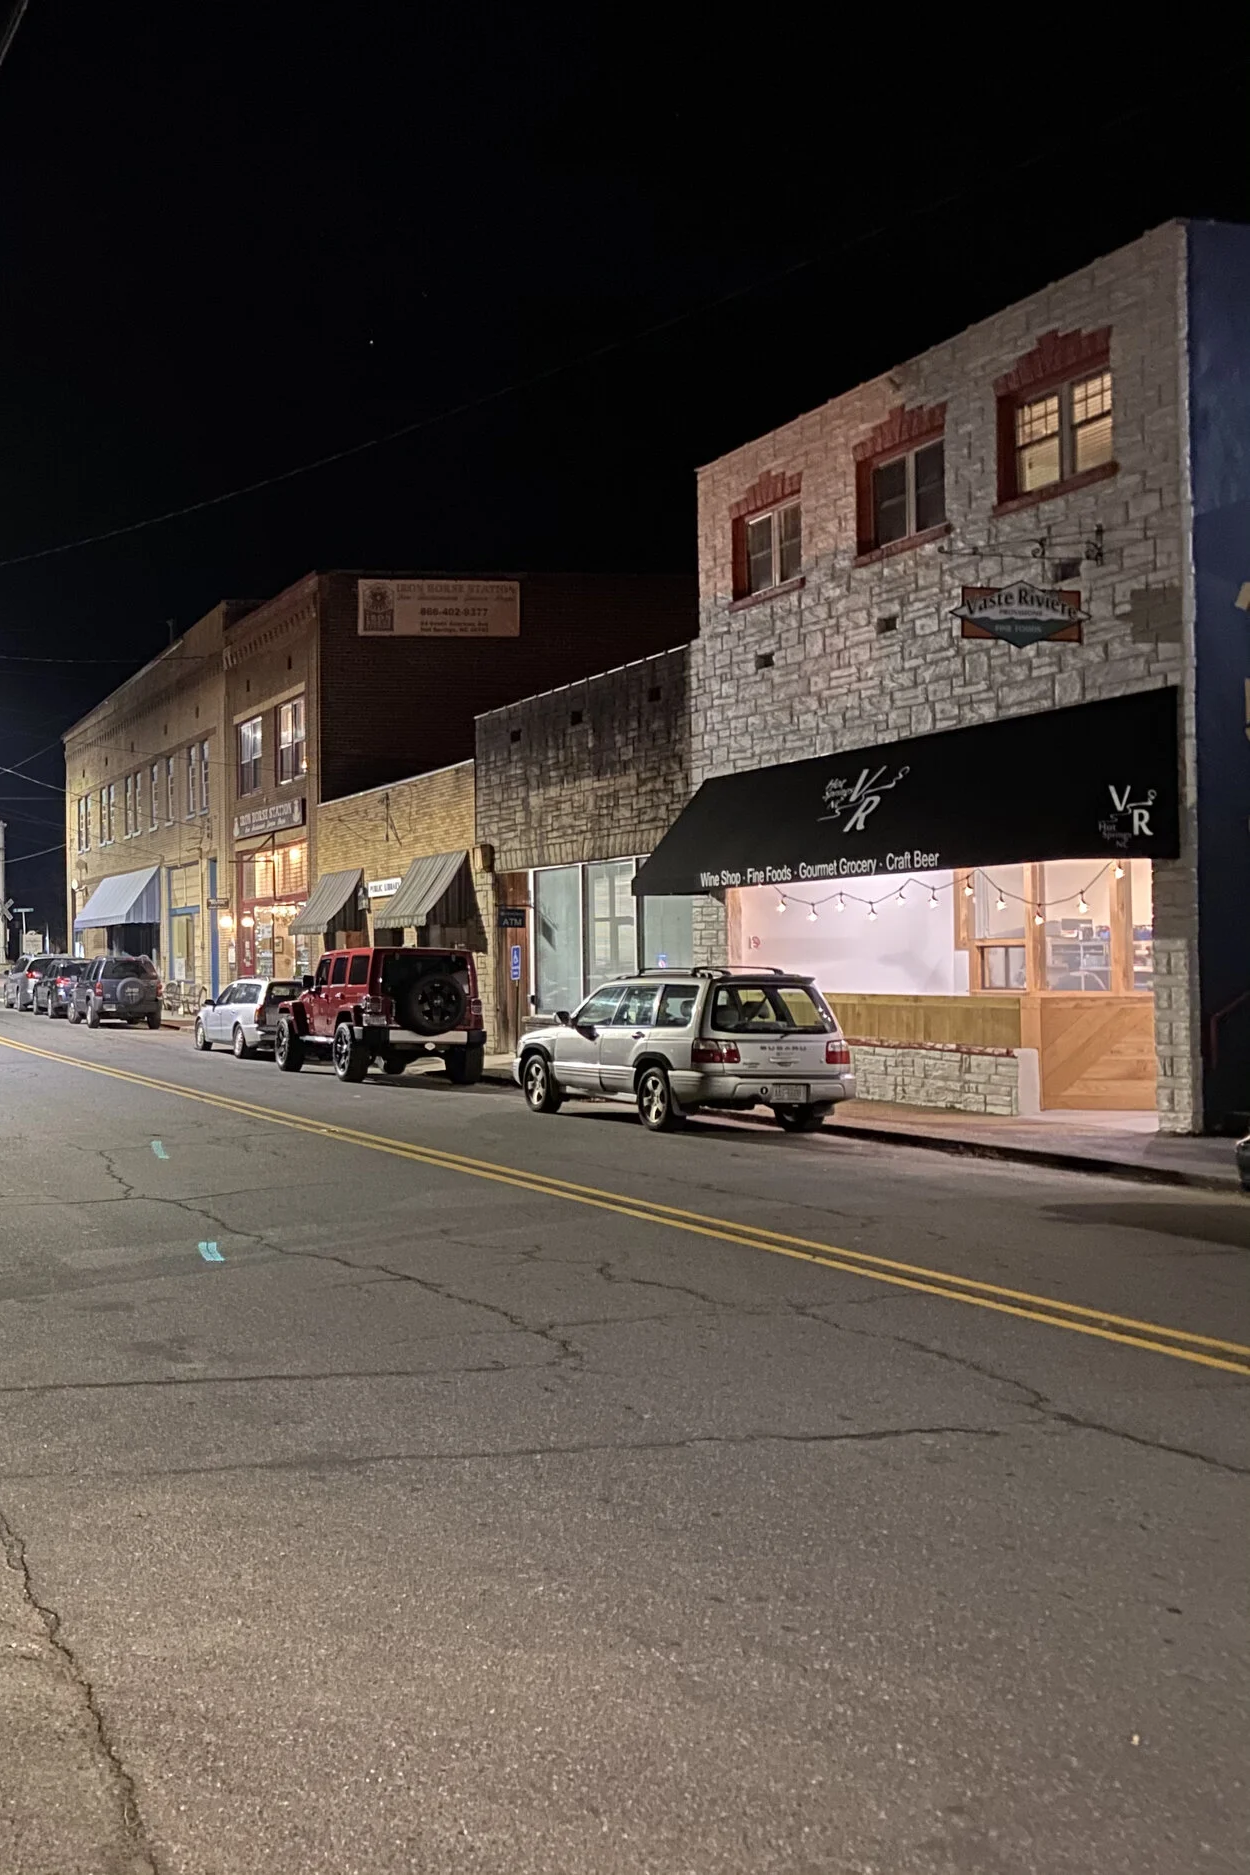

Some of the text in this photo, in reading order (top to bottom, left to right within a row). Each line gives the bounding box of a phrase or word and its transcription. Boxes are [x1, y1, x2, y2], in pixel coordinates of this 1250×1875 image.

[965, 592, 1014, 615] Vaste
[1108, 785, 1131, 812] V
[1133, 808, 1154, 836] R
[700, 849, 940, 888] Wine Shop Fine Foods Gourmet Grocery Craft Beer
[502, 918, 522, 926] ATM
